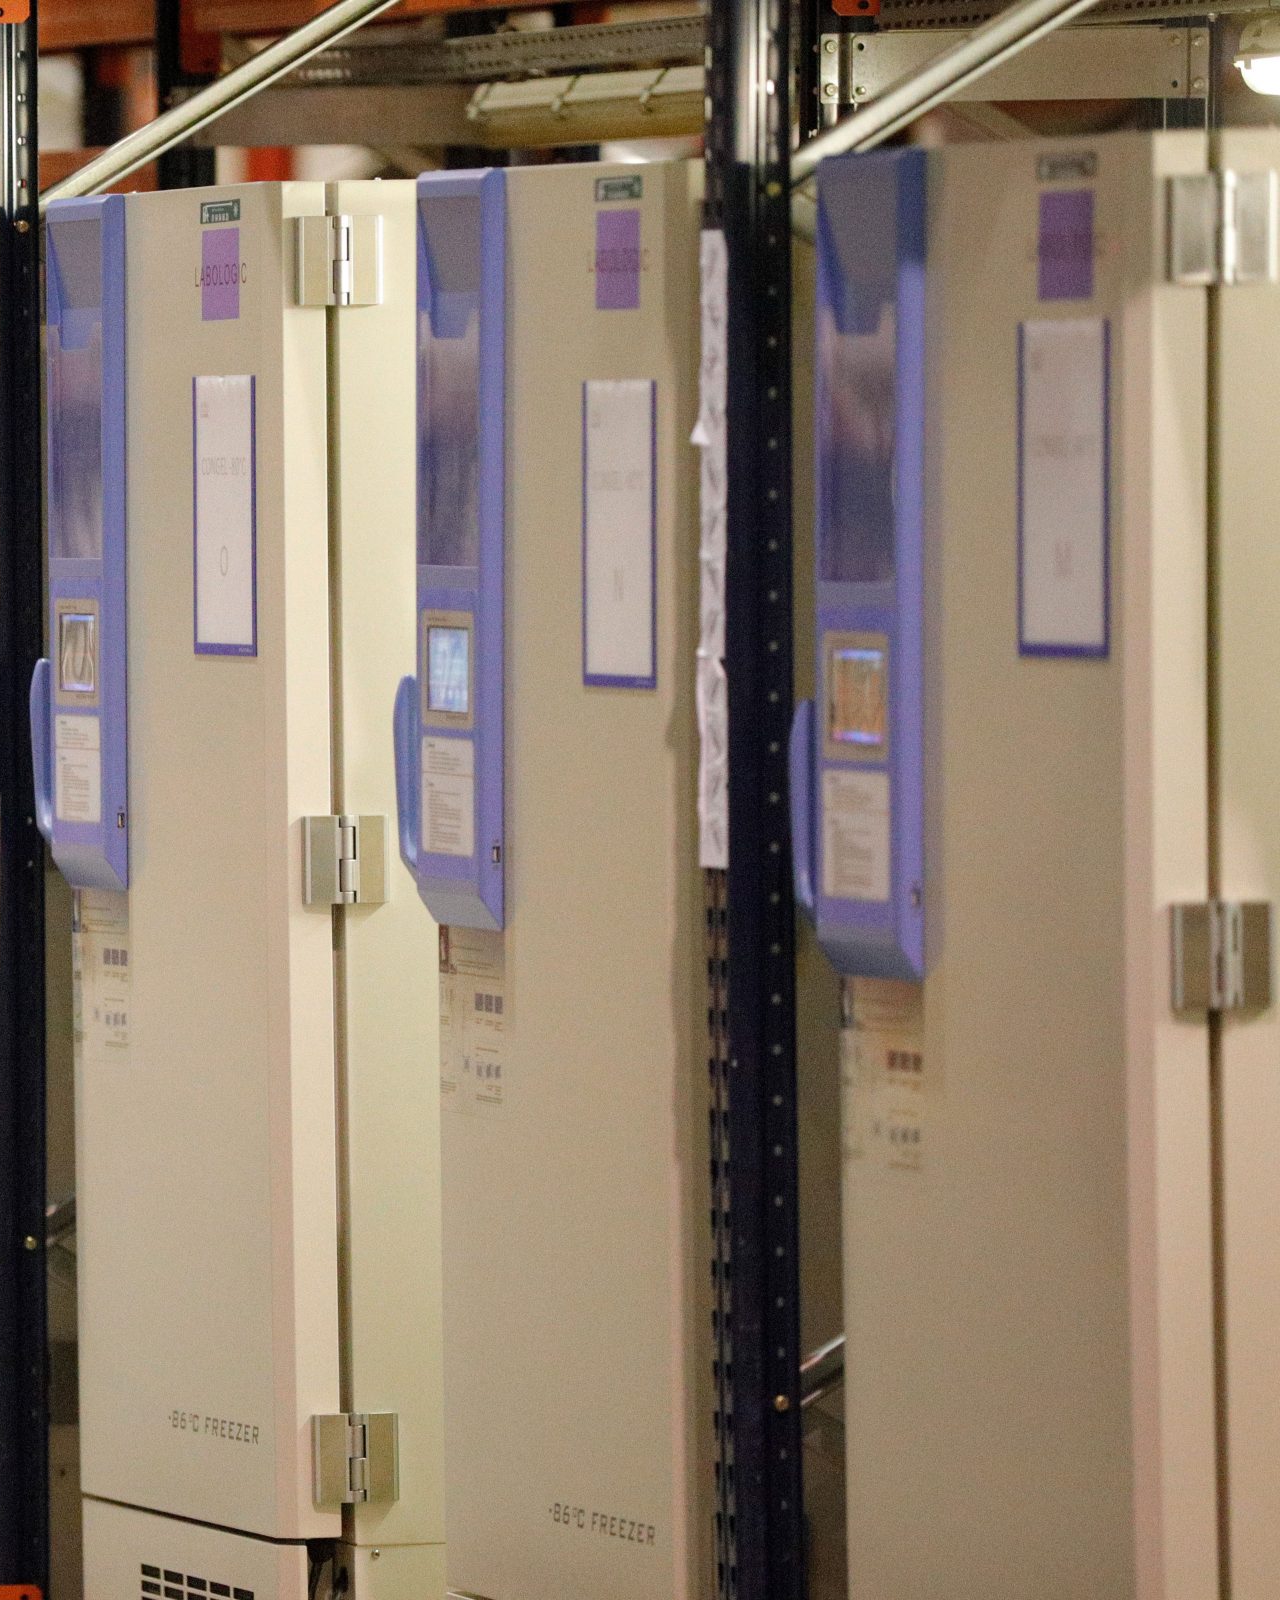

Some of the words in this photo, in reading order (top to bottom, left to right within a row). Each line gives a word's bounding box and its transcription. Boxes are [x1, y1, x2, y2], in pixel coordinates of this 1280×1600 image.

[195, 262, 247, 287] LABOLOGIC
[168, 1410, 199, 1433] -86°C
[204, 1416, 259, 1445] FREEZER
[548, 1503, 585, 1528] -86°C
[591, 1512, 656, 1546] FREEZER
